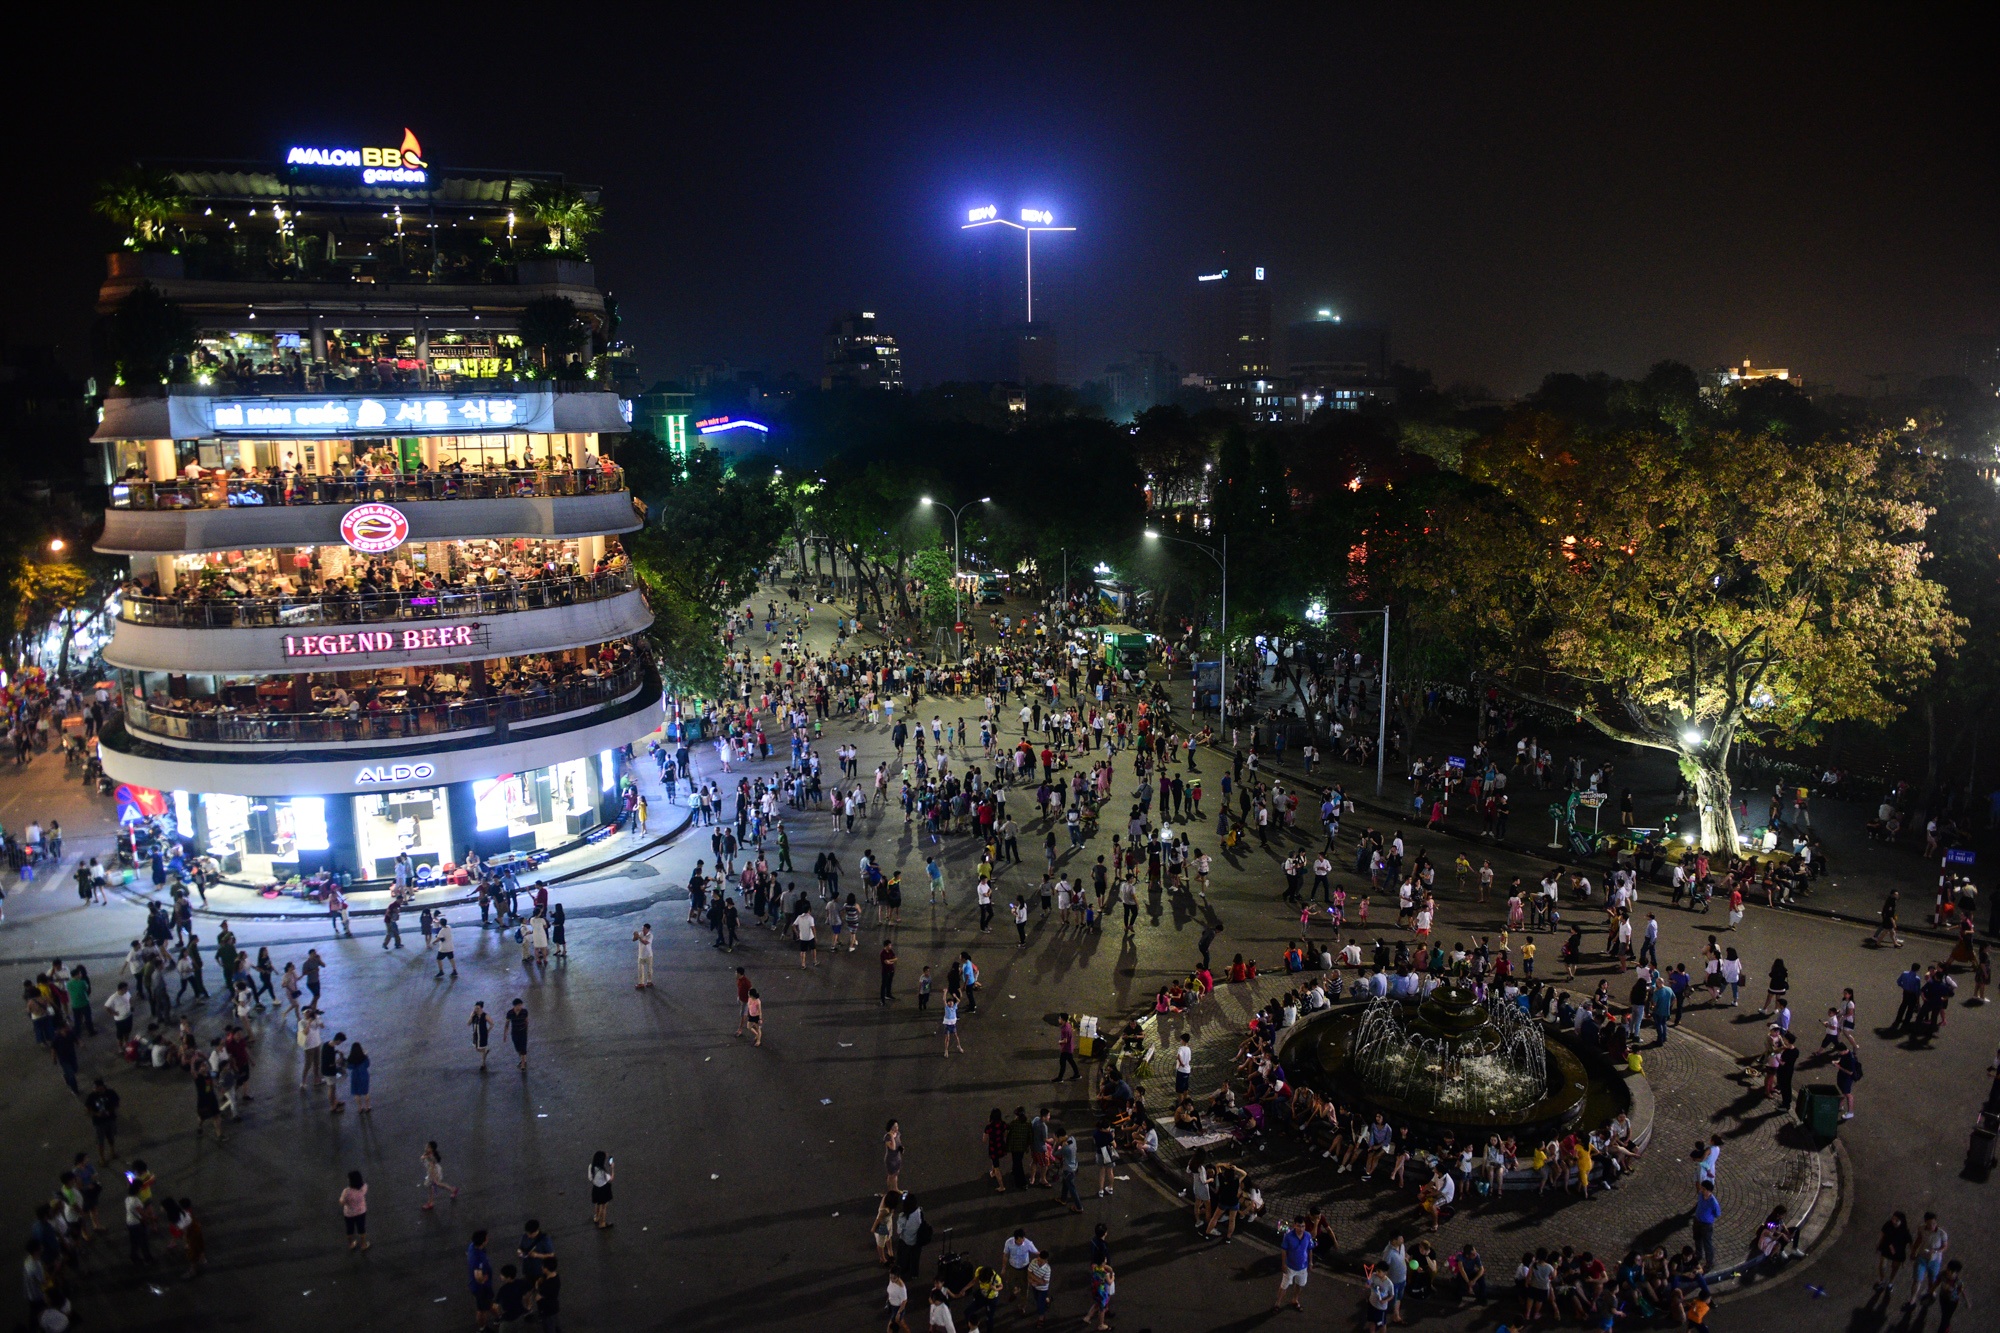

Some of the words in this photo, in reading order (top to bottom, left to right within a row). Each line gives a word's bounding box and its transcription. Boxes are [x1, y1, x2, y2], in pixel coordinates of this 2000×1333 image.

[287, 147, 361, 167] AVALON
[363, 168, 426, 184] garden
[395, 401, 450, 424] 서울
[458, 400, 517, 422] 식당
[344, 507, 404, 528] HIGHLANDS
[353, 536, 399, 550] COFFEE
[286, 631, 393, 656] LEGEND
[403, 625, 473, 650] BEER
[356, 763, 434, 784] ALDO
